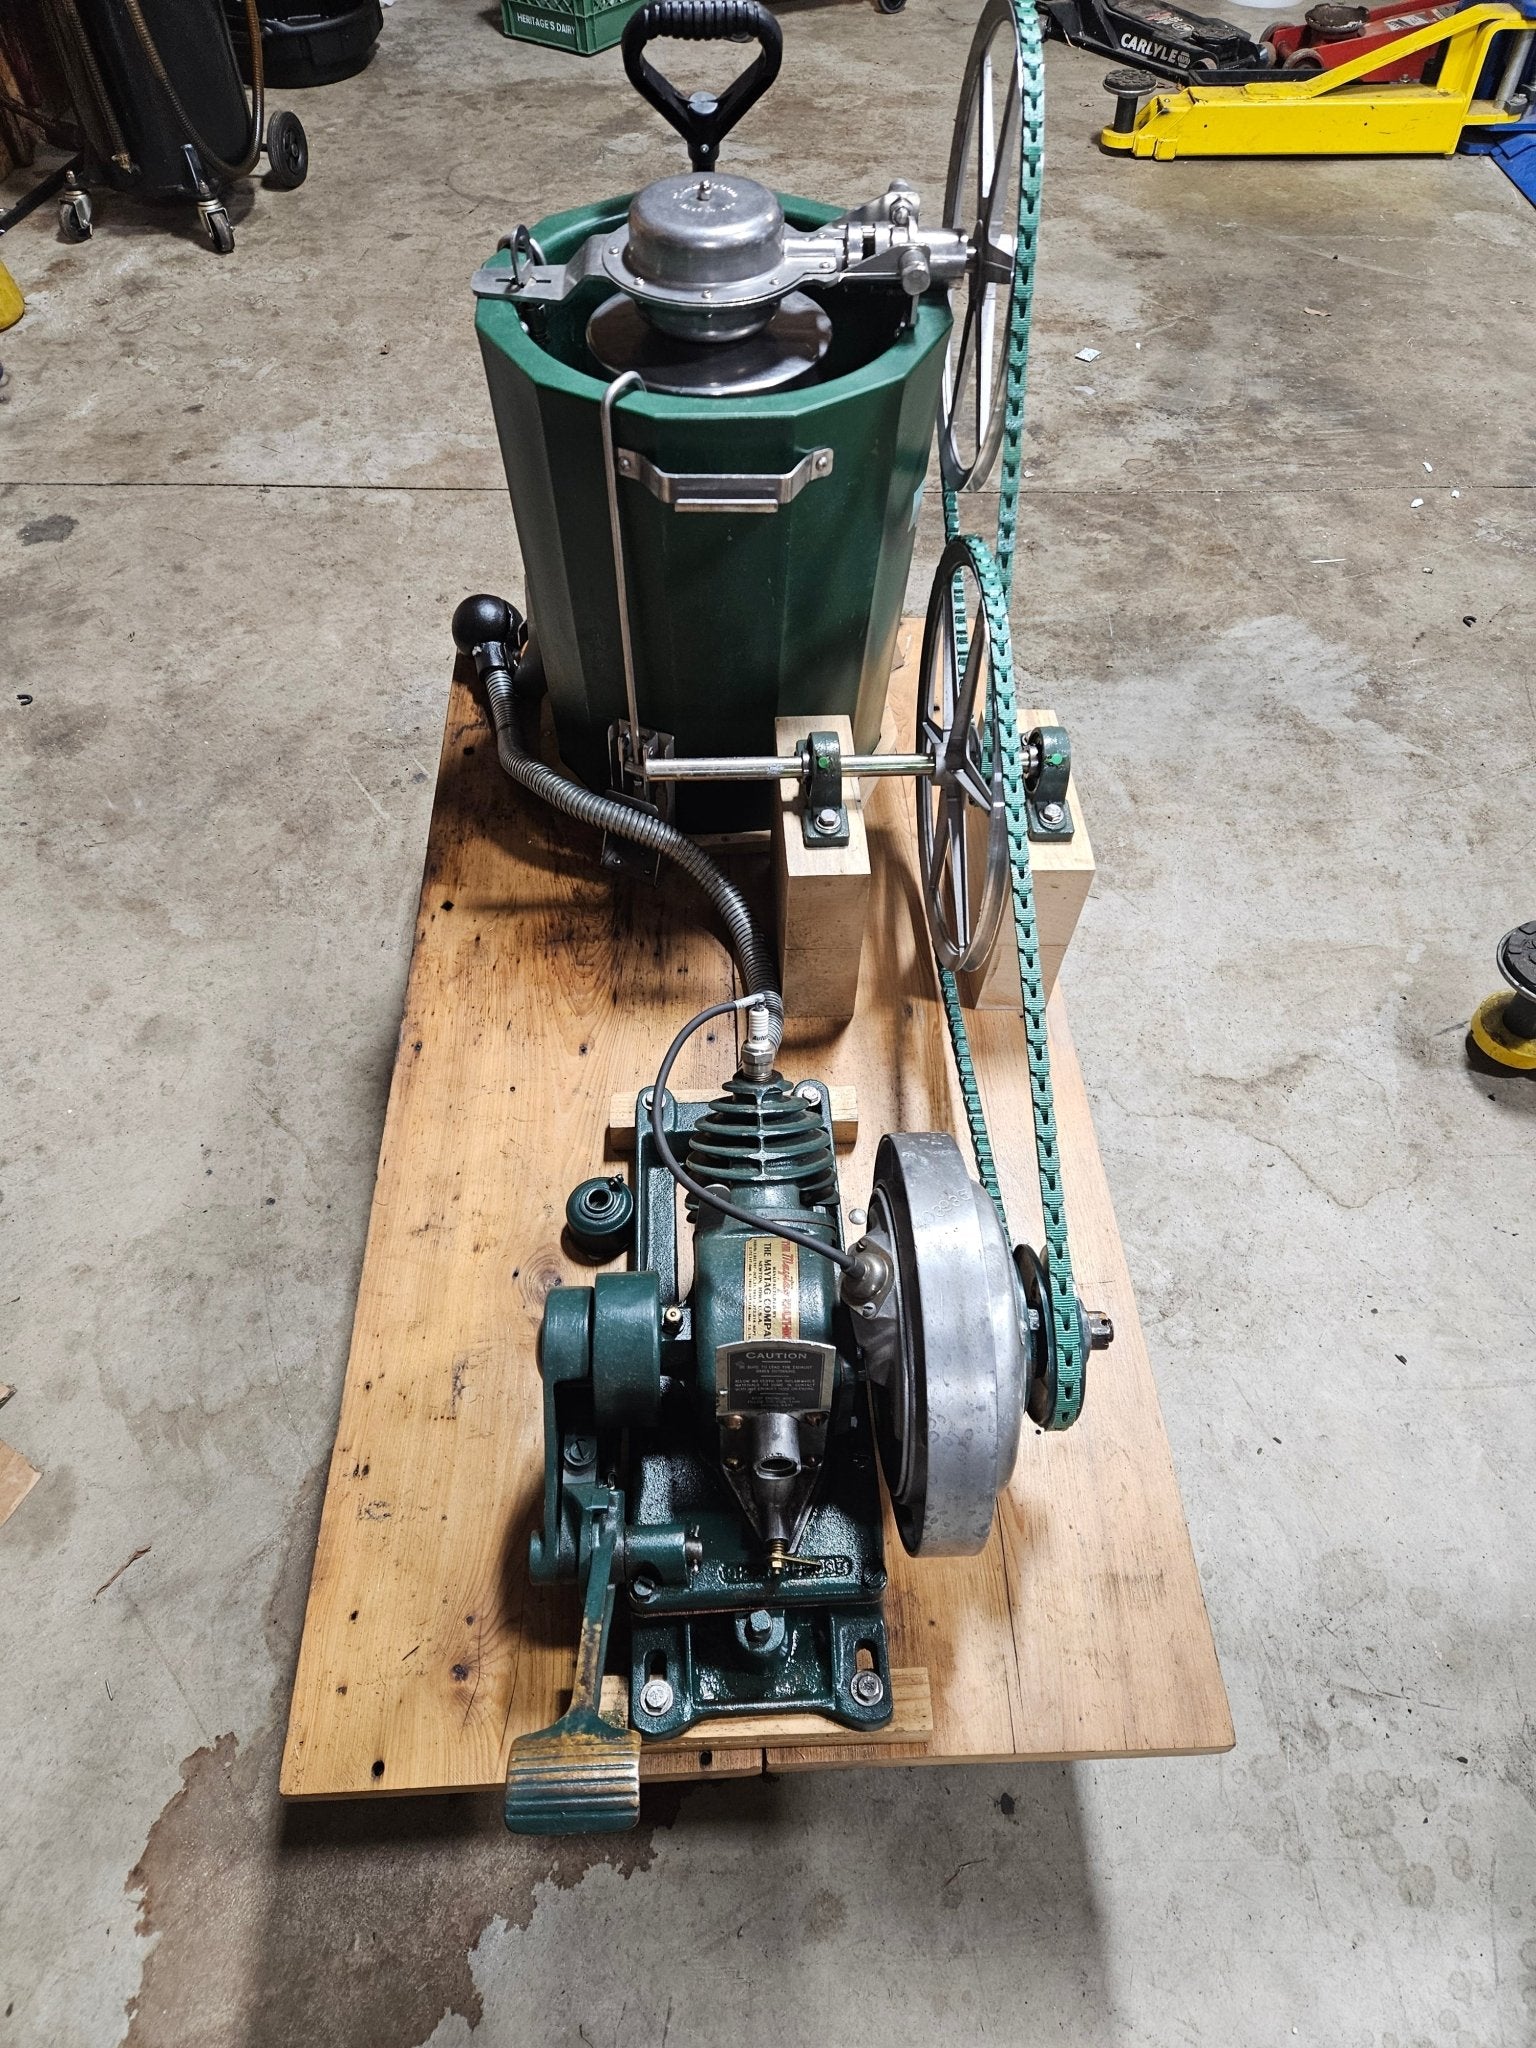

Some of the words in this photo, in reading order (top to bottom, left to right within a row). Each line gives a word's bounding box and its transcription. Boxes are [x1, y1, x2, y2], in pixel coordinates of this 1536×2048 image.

[516, 12, 555, 31] HERITAGE'S
[556, 22, 575, 35] DAIRY
[1121, 33, 1179, 64] CARLYLE
[763, 1242, 772, 1257] THE
[763, 1259, 772, 1295] MAYTAG
[745, 1351, 807, 1360] CAUTION
